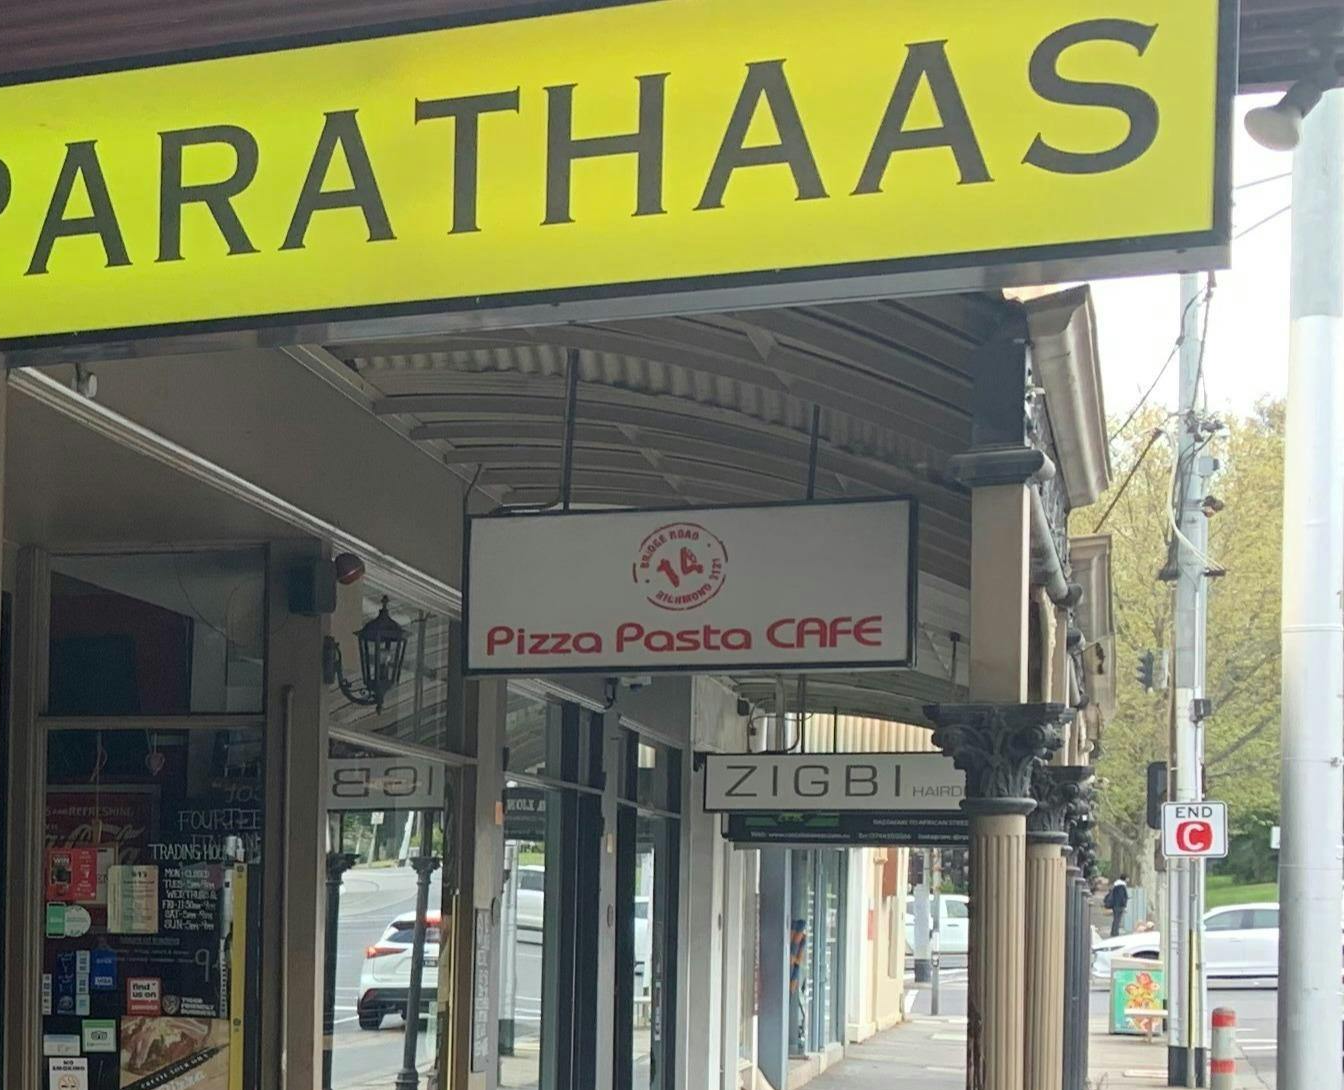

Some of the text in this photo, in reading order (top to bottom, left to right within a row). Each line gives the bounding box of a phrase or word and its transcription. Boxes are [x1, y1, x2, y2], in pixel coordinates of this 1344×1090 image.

[669, 529, 700, 541] ROAD
[656, 546, 704, 588] 14
[655, 582, 712, 605] RICHMOND
[487, 614, 884, 657] Pizza Pasta CAFE
[724, 764, 902, 798] ZIGBI
[1175, 806, 1213, 819] END
[1182, 823, 1205, 850] C
[132, 982, 151, 991] find
[132, 991, 157, 999] us on
